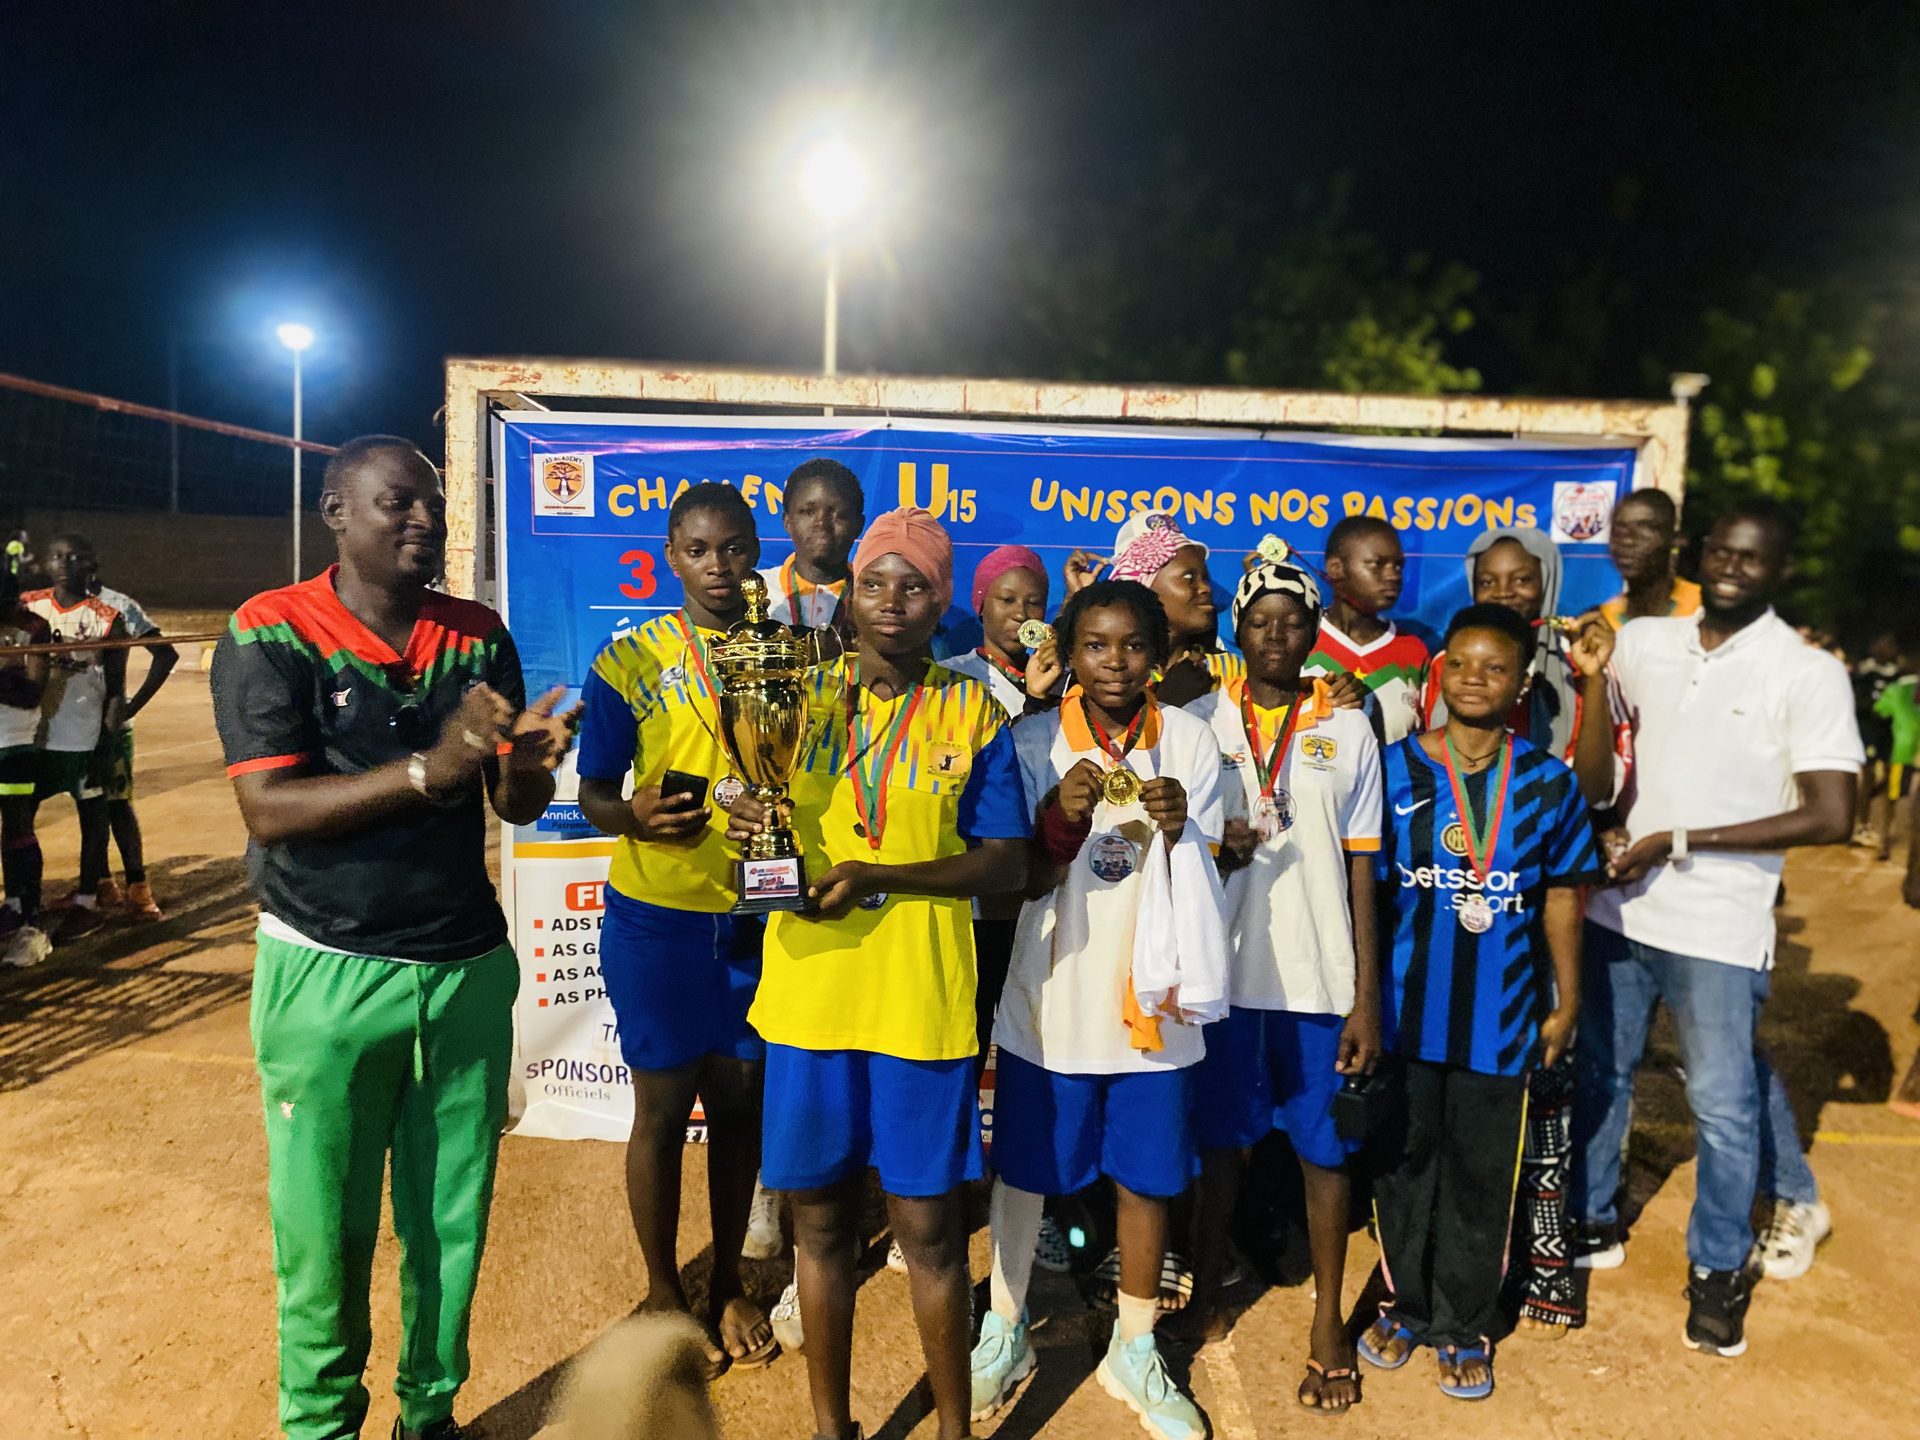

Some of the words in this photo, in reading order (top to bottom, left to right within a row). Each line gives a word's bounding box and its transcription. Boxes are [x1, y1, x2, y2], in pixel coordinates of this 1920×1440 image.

[1030, 477, 1237, 527] UNISSONS
[1249, 488, 1330, 528] NOS
[1342, 490, 1538, 531] PASSIONS
[541, 809, 580, 821] Annick
[551, 917, 592, 932] ADS
[552, 943, 578, 957] AS
[583, 942, 600, 955] G
[553, 967, 579, 982] AS
[554, 991, 580, 1006] AS
[526, 1058, 633, 1086] SPONSOR
[544, 1083, 611, 1101] Officiels
